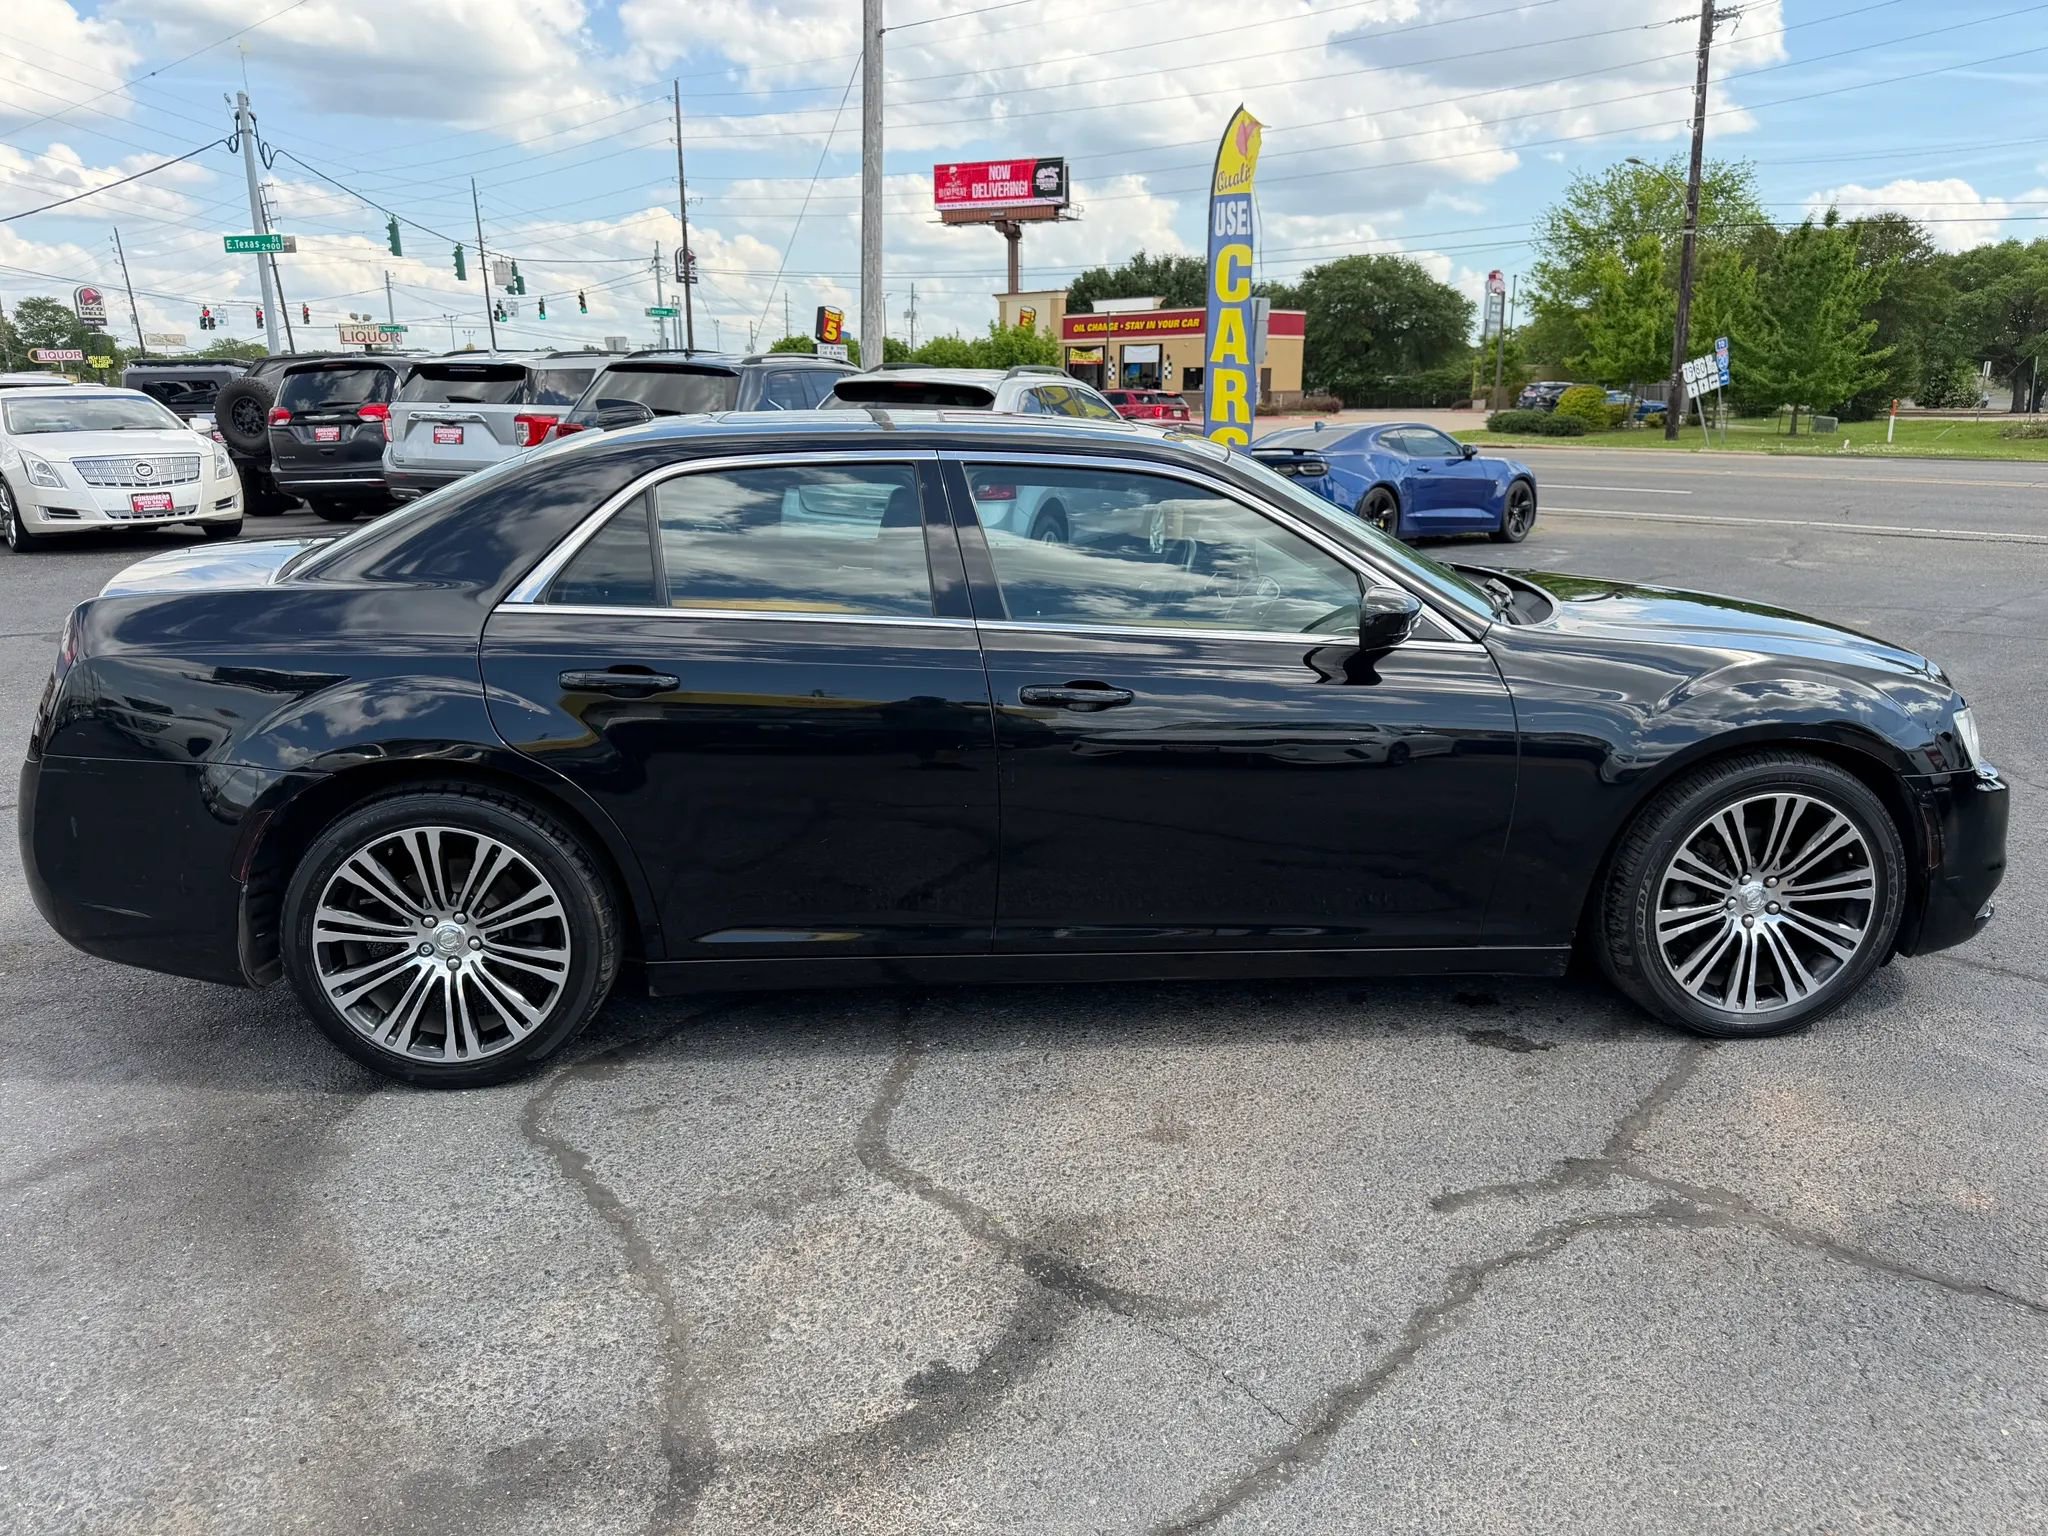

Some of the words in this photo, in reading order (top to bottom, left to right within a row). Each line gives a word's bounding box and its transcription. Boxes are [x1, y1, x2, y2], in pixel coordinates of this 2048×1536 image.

[988, 165, 1012, 180] NOW
[971, 181, 1028, 198] DELIVERING!
[261, 243, 280, 251] 2900
[823, 319, 838, 341] 5
[1073, 323, 1086, 333] OIL
[1087, 321, 1119, 332] CHANGE
[1124, 320, 1146, 330] STAY
[1146, 320, 1157, 329] IN
[1157, 318, 1181, 329] YOUR
[1181, 317, 1201, 328] CAR
[341, 331, 401, 343] LIQUOR
[38, 350, 82, 360] LIQUOR
